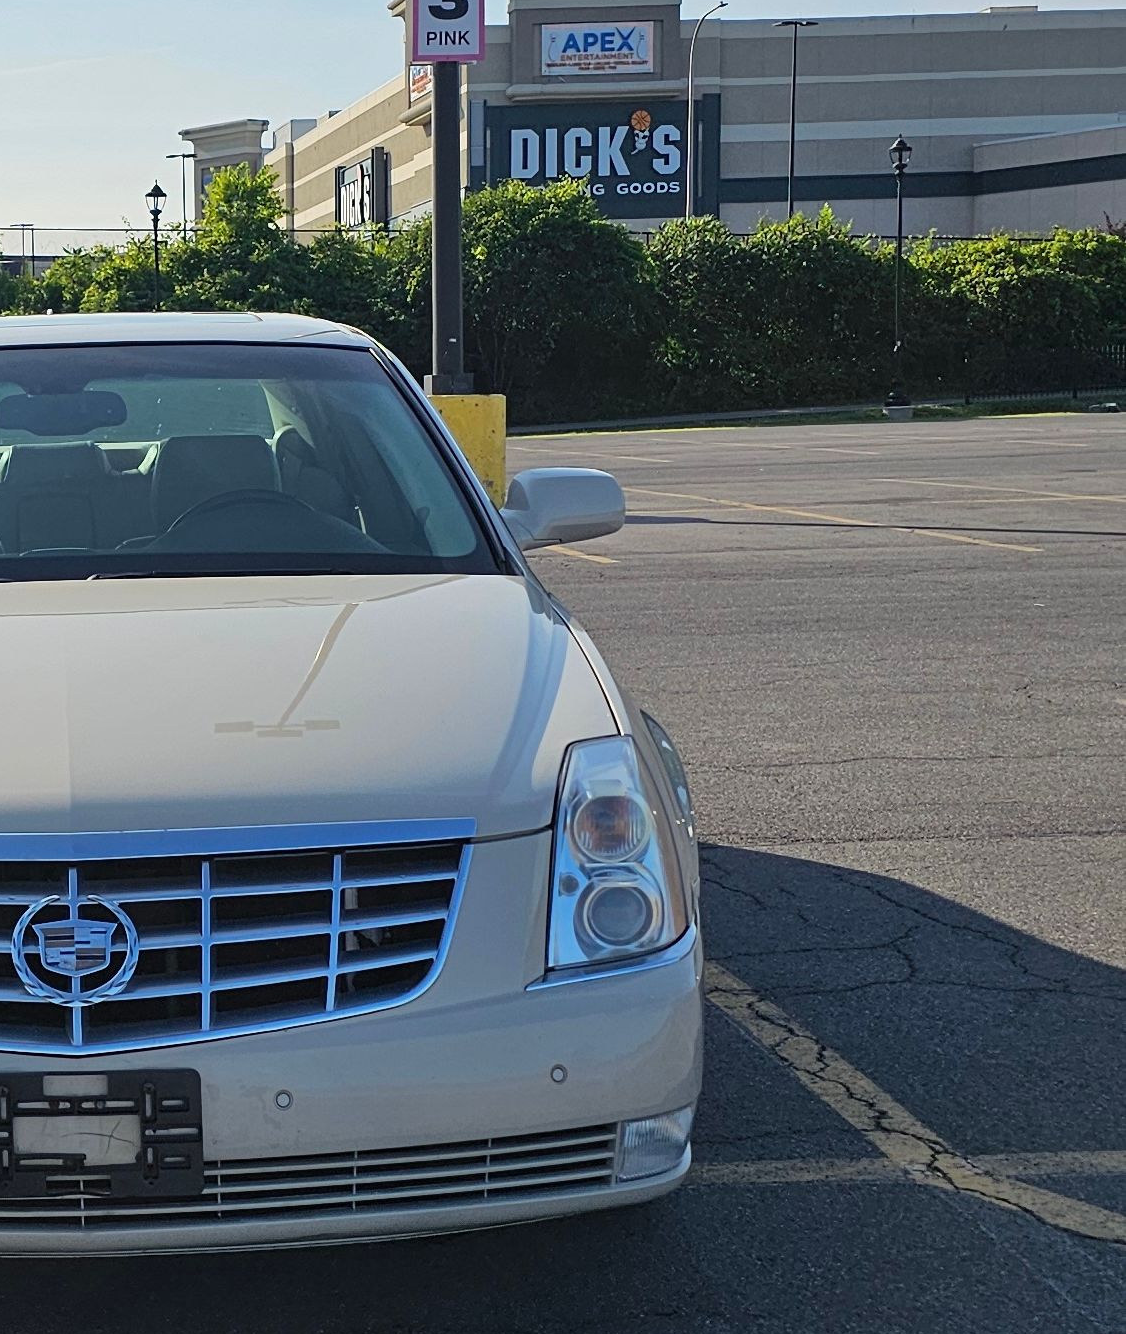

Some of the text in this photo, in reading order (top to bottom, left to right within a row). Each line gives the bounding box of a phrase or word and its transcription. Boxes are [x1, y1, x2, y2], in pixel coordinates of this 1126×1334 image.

[426, 31, 470, 46] PINK
[562, 27, 636, 53] APEX
[560, 53, 634, 61] ENTERTAINMENT
[510, 124, 681, 179] DICK'S
[616, 182, 680, 195] GOODS
